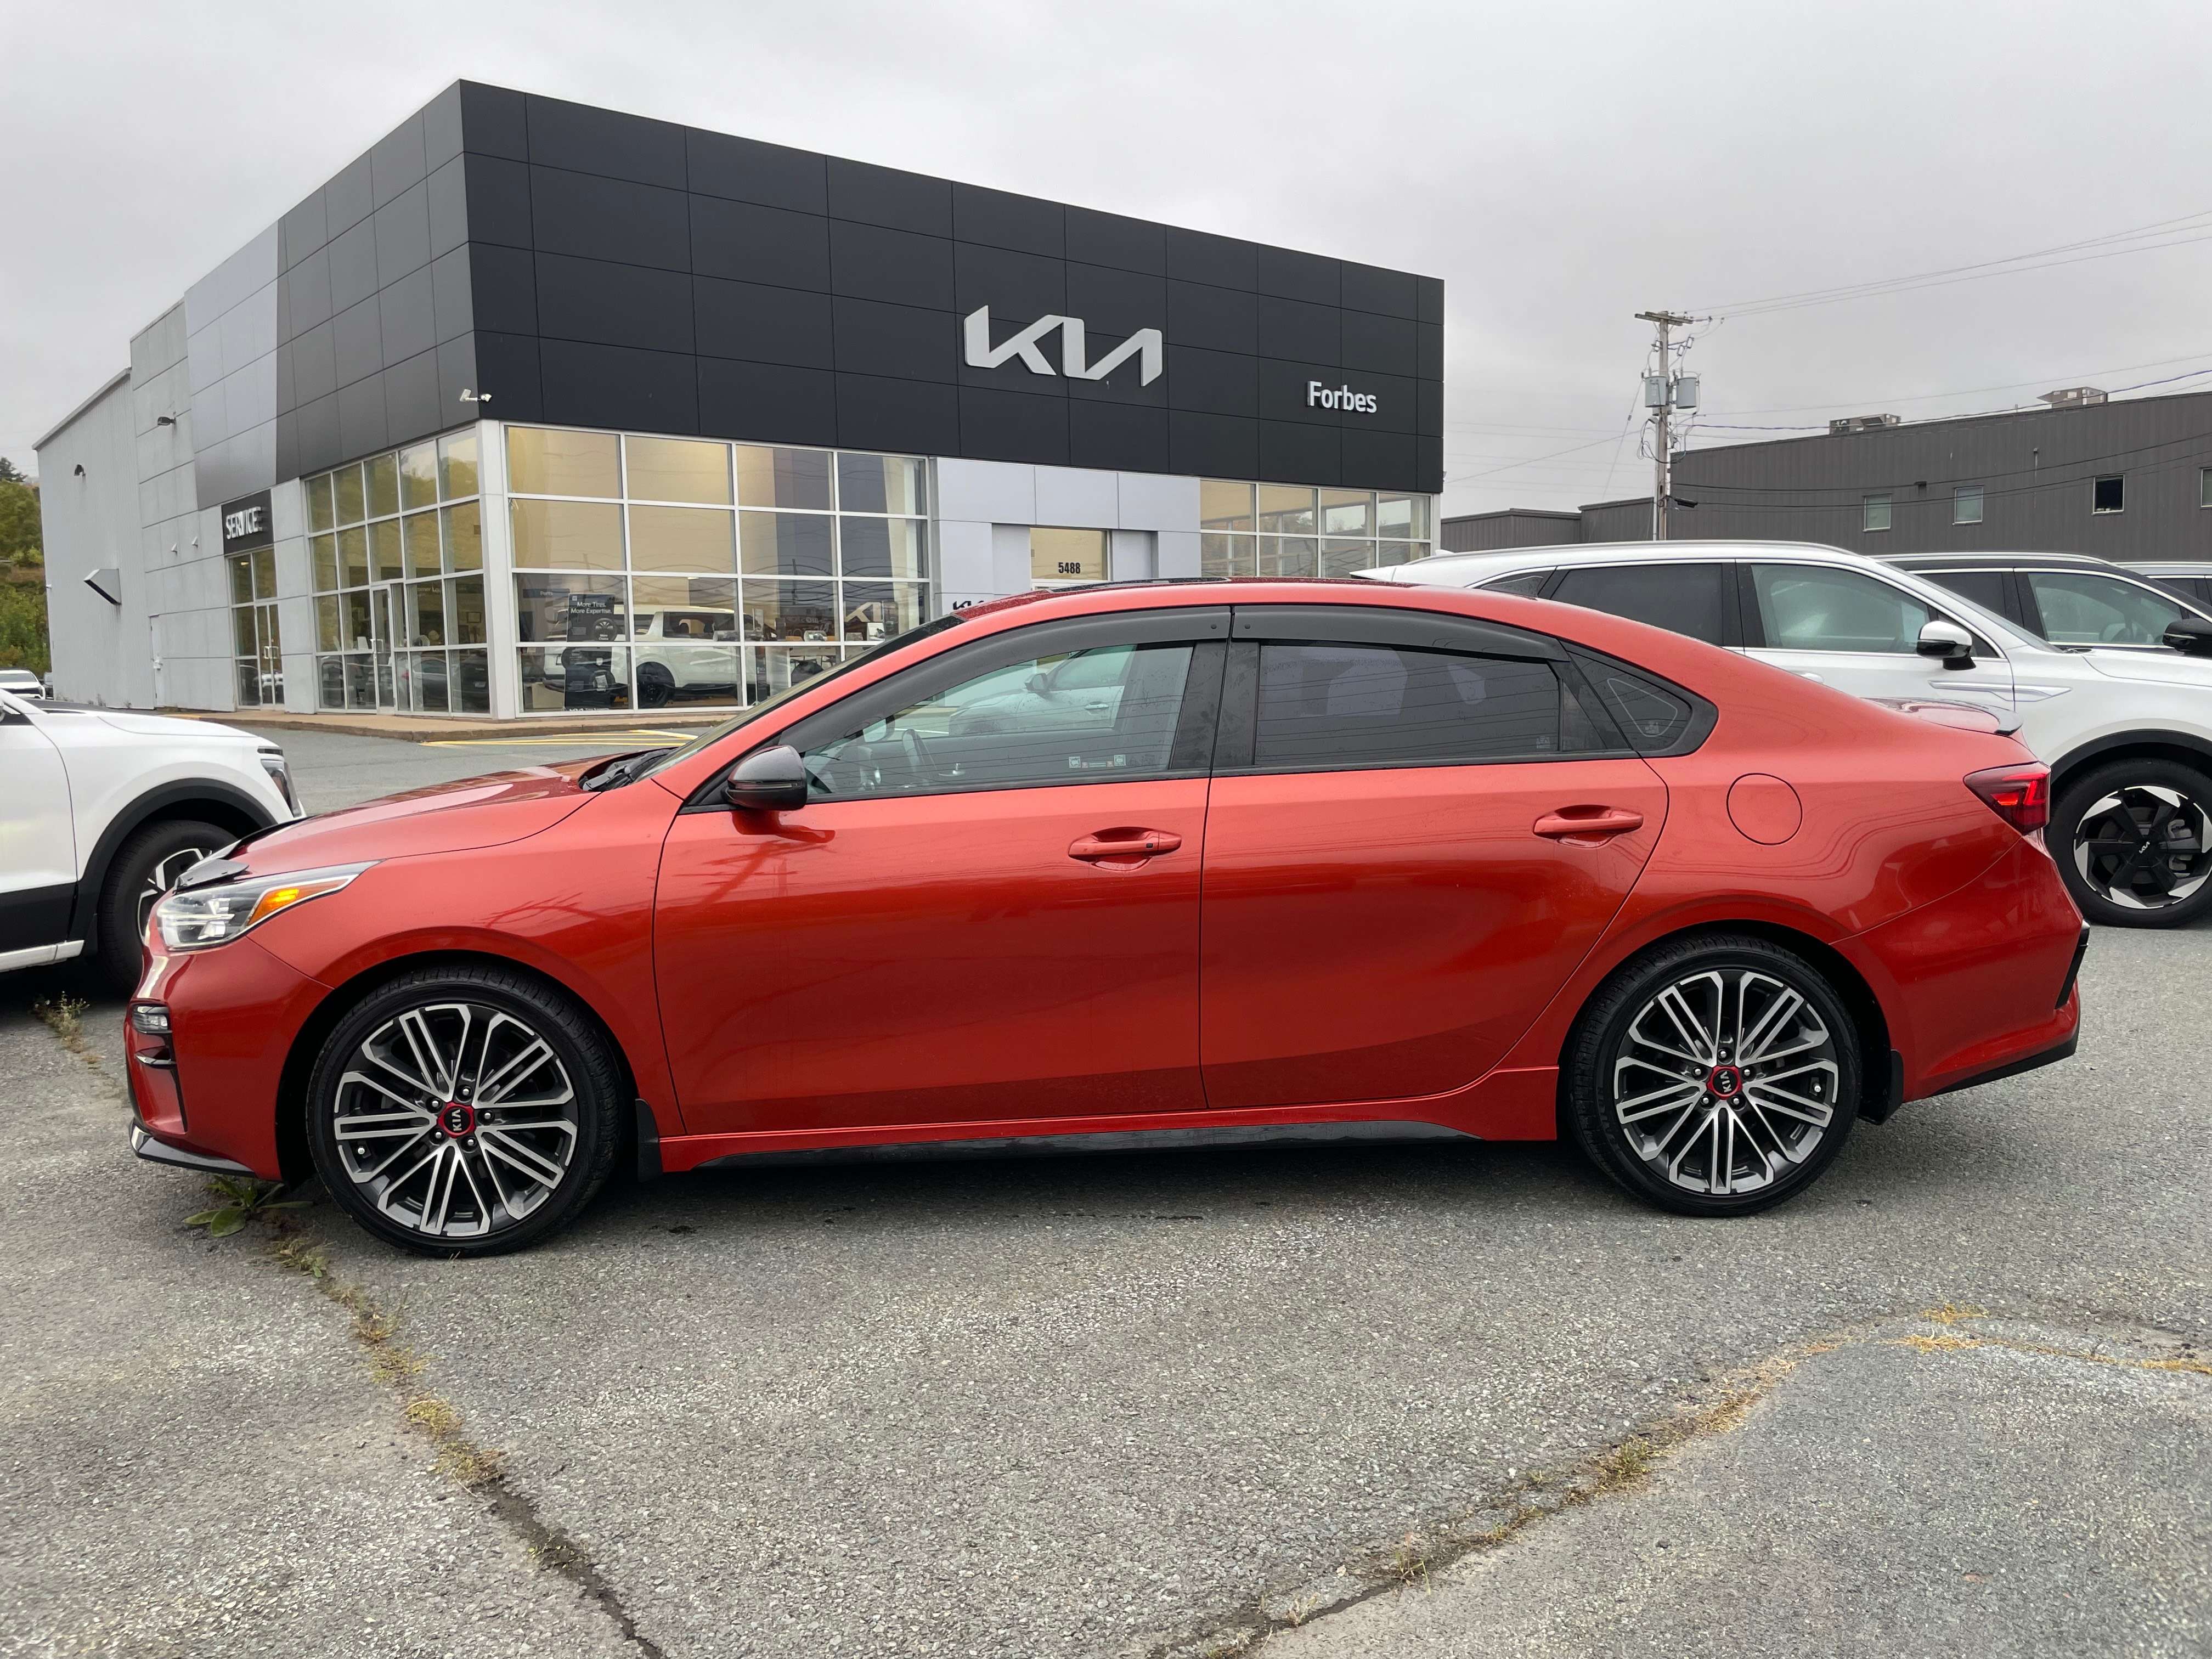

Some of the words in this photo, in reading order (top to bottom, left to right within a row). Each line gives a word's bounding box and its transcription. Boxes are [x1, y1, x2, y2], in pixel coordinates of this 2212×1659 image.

[963, 304, 1163, 387] KIA
[1307, 381, 1378, 413] Forbes
[226, 506, 263, 539] SERVICE
[1058, 562, 1081, 574] 5488
[1720, 1071, 1732, 1093] KIA
[452, 1109, 462, 1132] KIA
